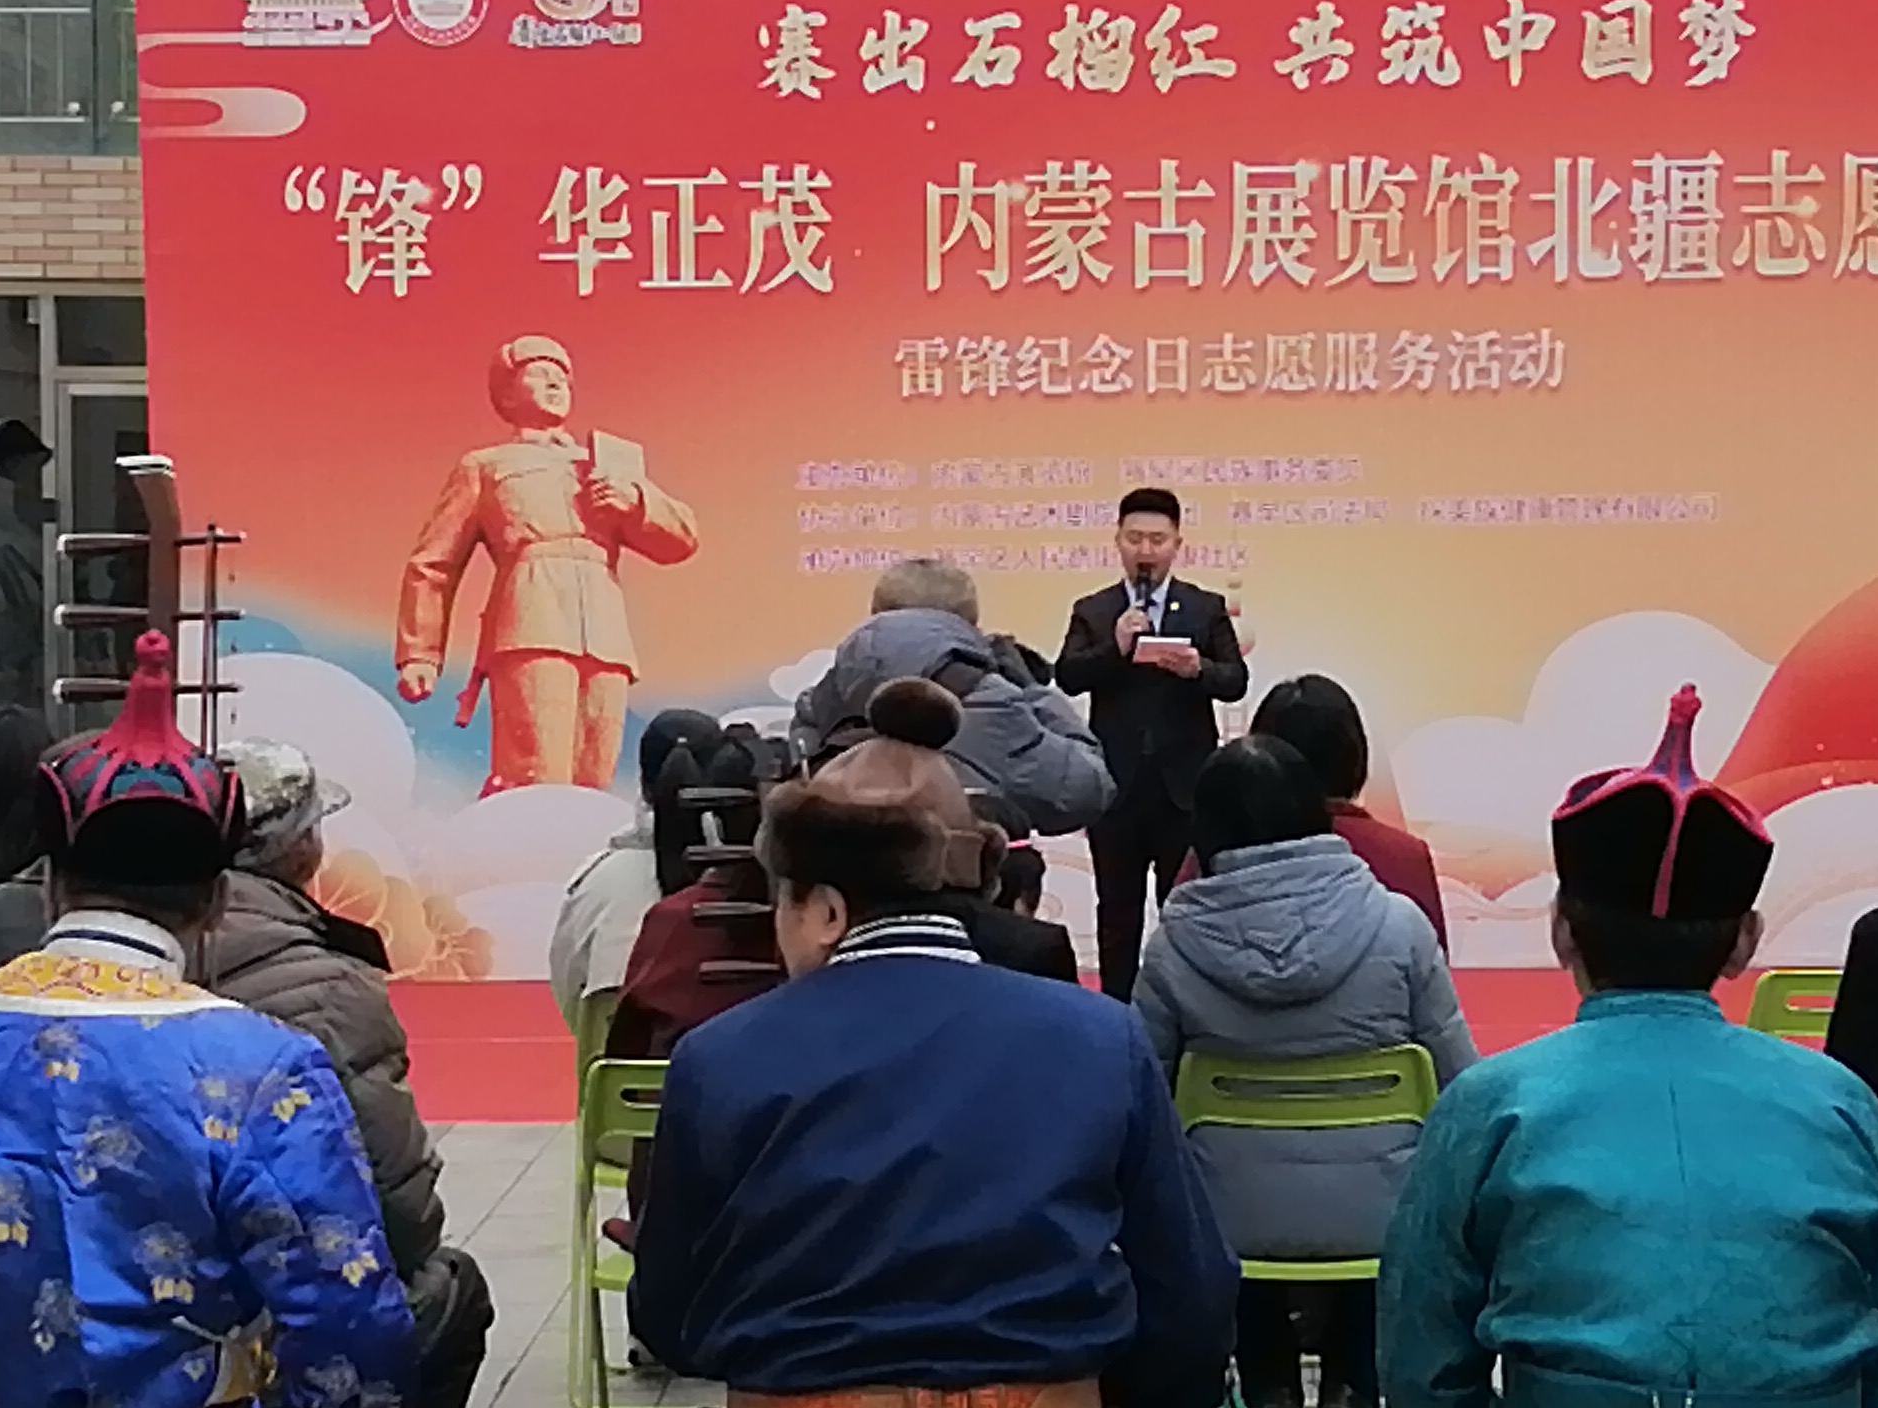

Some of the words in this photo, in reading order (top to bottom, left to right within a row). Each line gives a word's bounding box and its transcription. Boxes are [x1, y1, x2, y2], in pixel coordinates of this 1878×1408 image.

[757, 2, 1238, 100] 赛出石榴红
[894, 329, 1566, 398] 雷锋纪念日志愿服务活动
